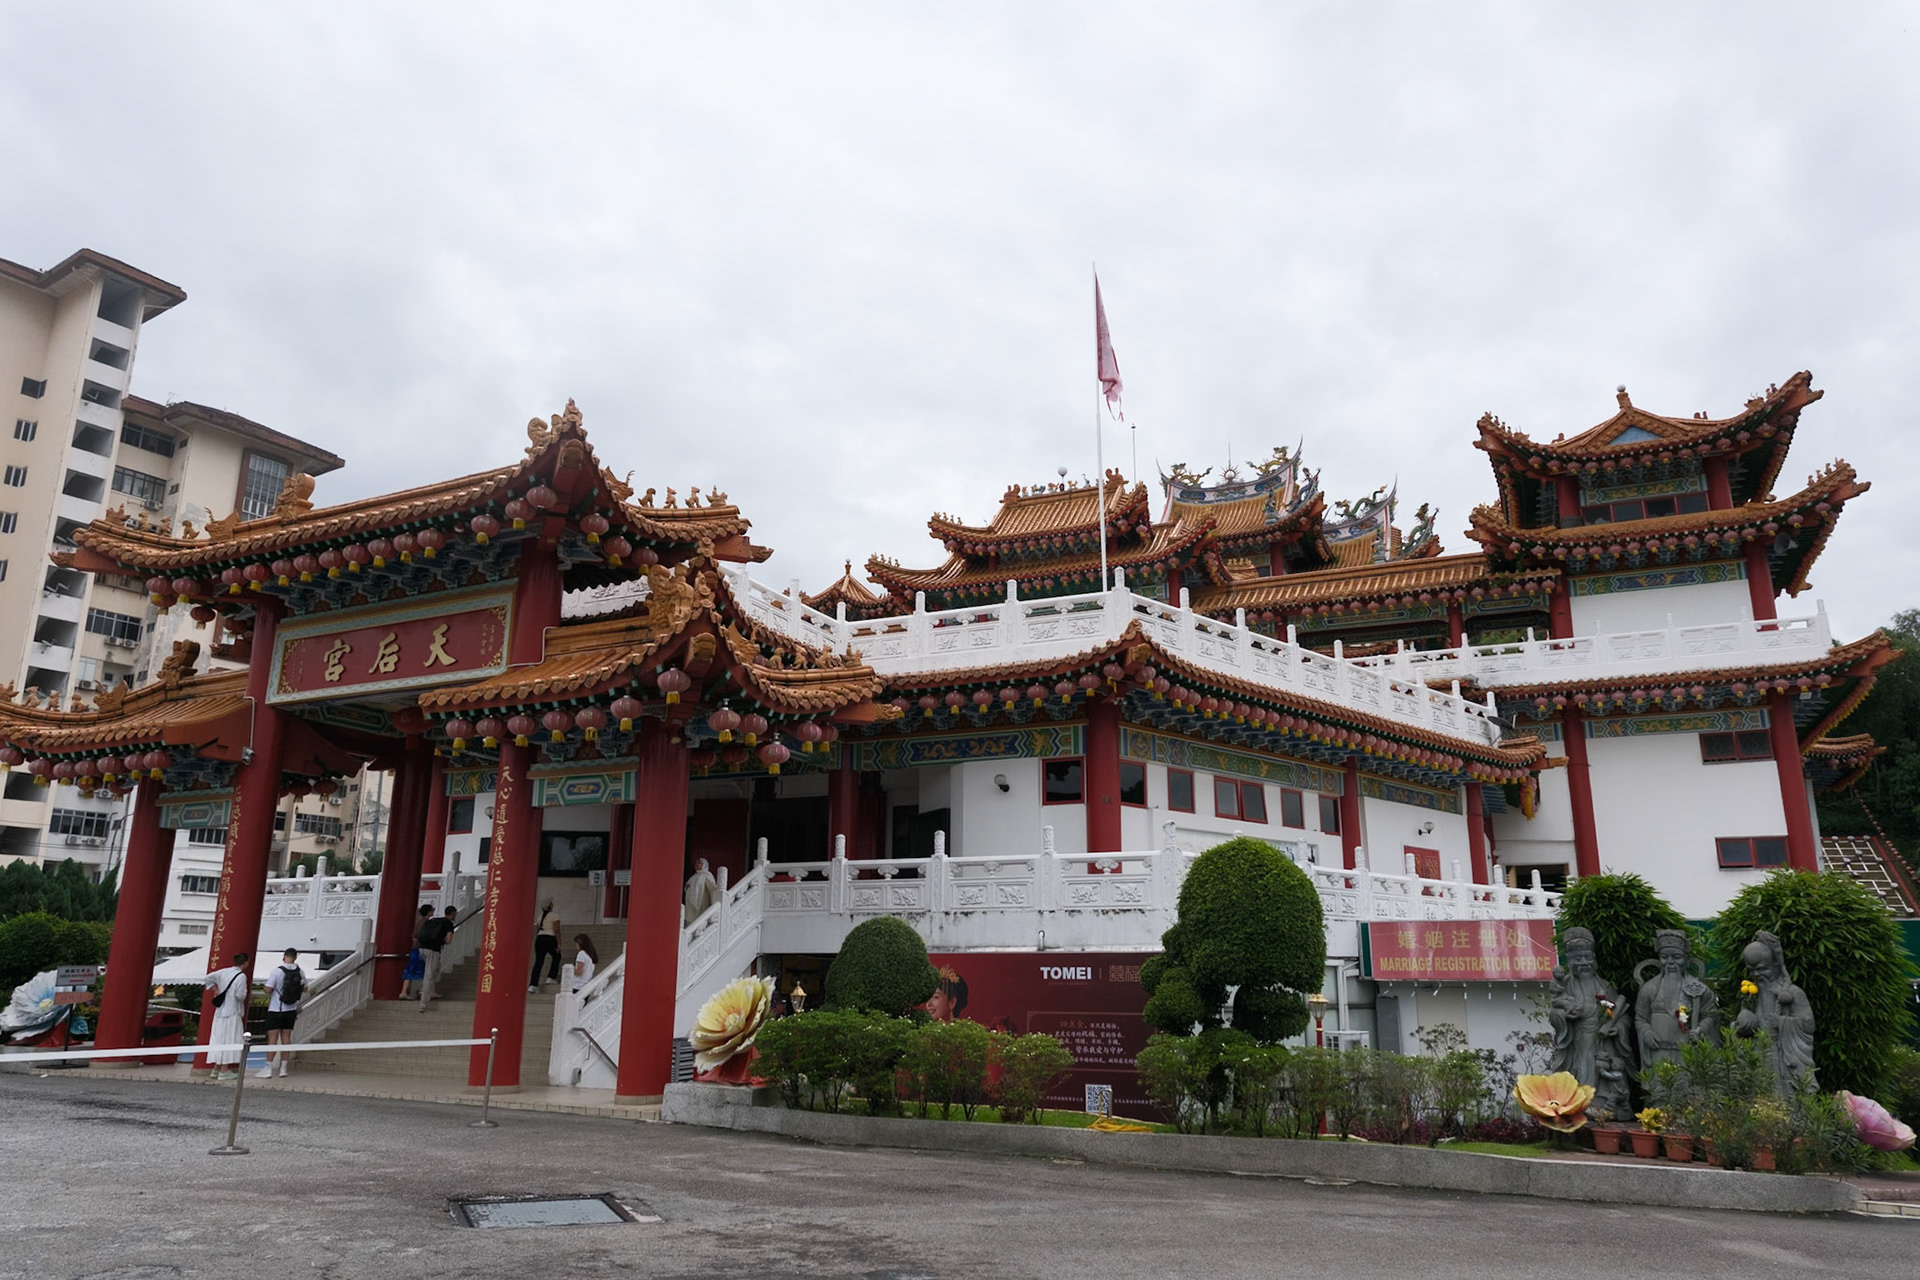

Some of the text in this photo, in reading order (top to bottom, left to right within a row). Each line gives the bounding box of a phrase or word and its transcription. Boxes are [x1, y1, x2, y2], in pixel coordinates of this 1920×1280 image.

[1397, 929, 1528, 949] 婚姻注册处
[1380, 956, 1552, 972] MARRIAGE REGISTRATION OFFICE
[1040, 966, 1092, 980] TOMEI
